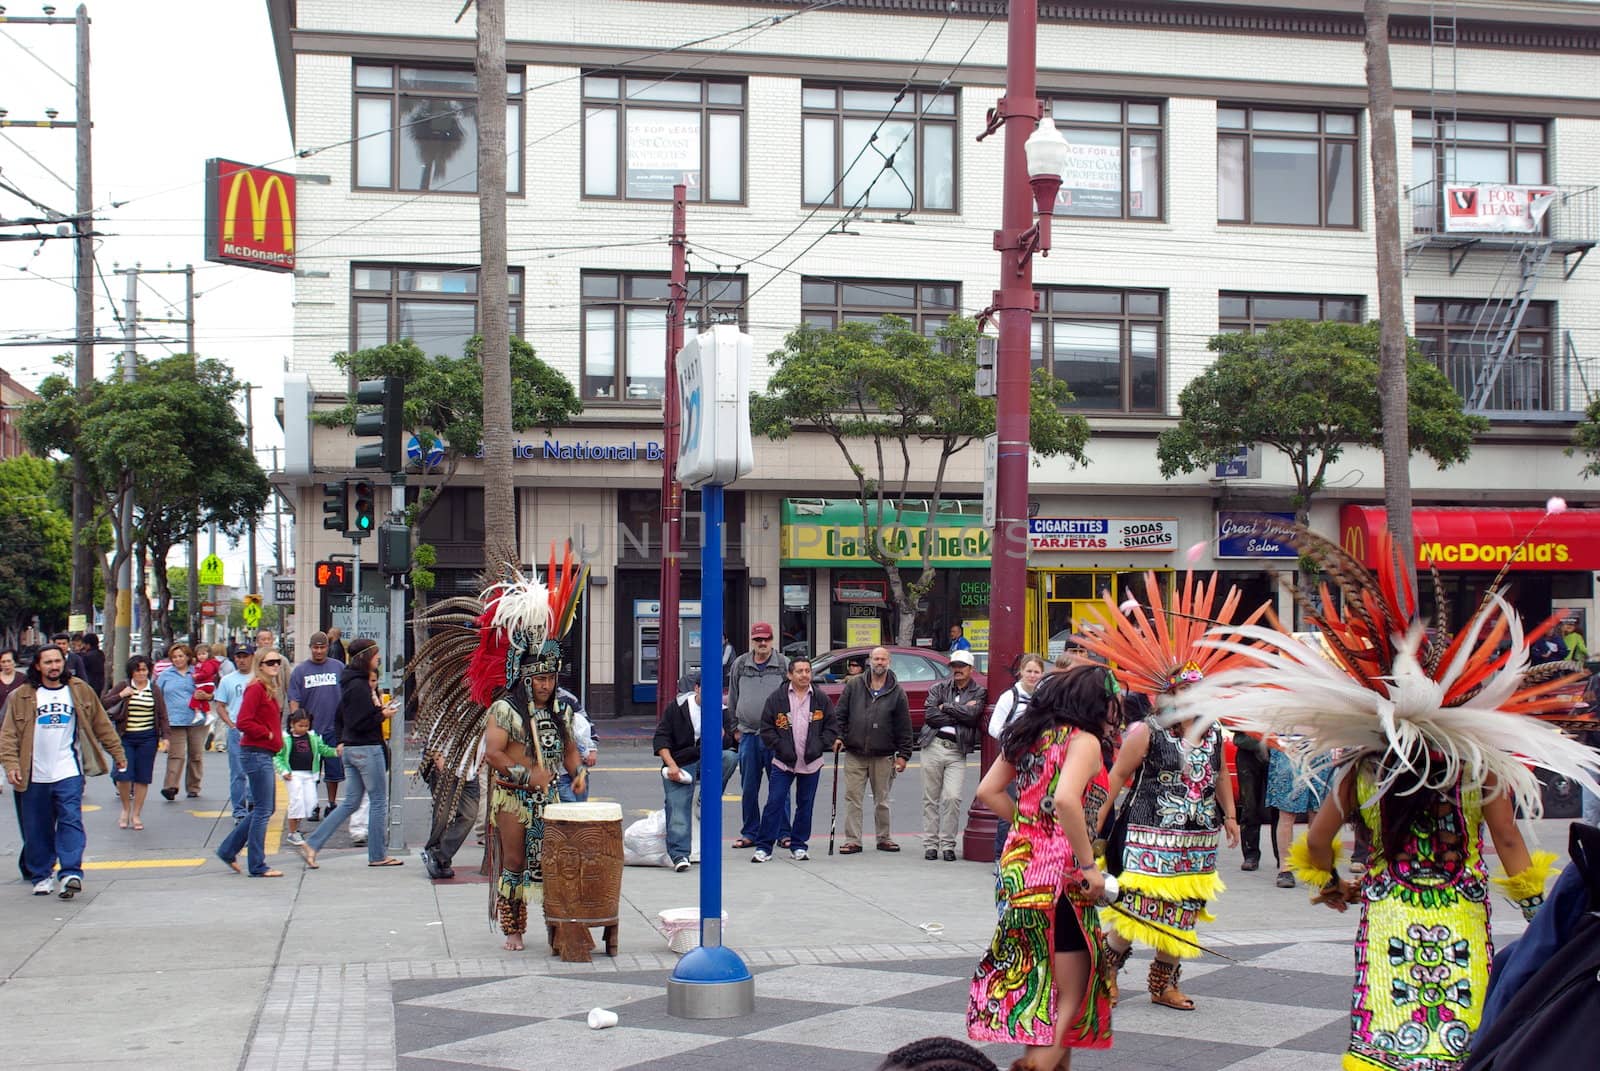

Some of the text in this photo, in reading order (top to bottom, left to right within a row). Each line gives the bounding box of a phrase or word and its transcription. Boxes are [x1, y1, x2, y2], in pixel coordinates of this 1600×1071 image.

[1488, 189, 1515, 203] FOR
[1482, 203, 1524, 217] LEASE
[224, 243, 294, 264] McDonald's
[542, 439, 638, 461] National
[1034, 520, 1103, 533] CIGARETTES
[1123, 522, 1164, 536] SODAS
[1221, 518, 1257, 536] Great
[1031, 537, 1107, 548] TARJETAS
[1123, 532, 1173, 547] SNACKS
[1246, 538, 1280, 552] Salon
[1419, 542, 1569, 562] McDonald's
[368, 604, 389, 613] Bank
[852, 605, 875, 616] OPEN
[304, 673, 337, 688] PRIMOS
